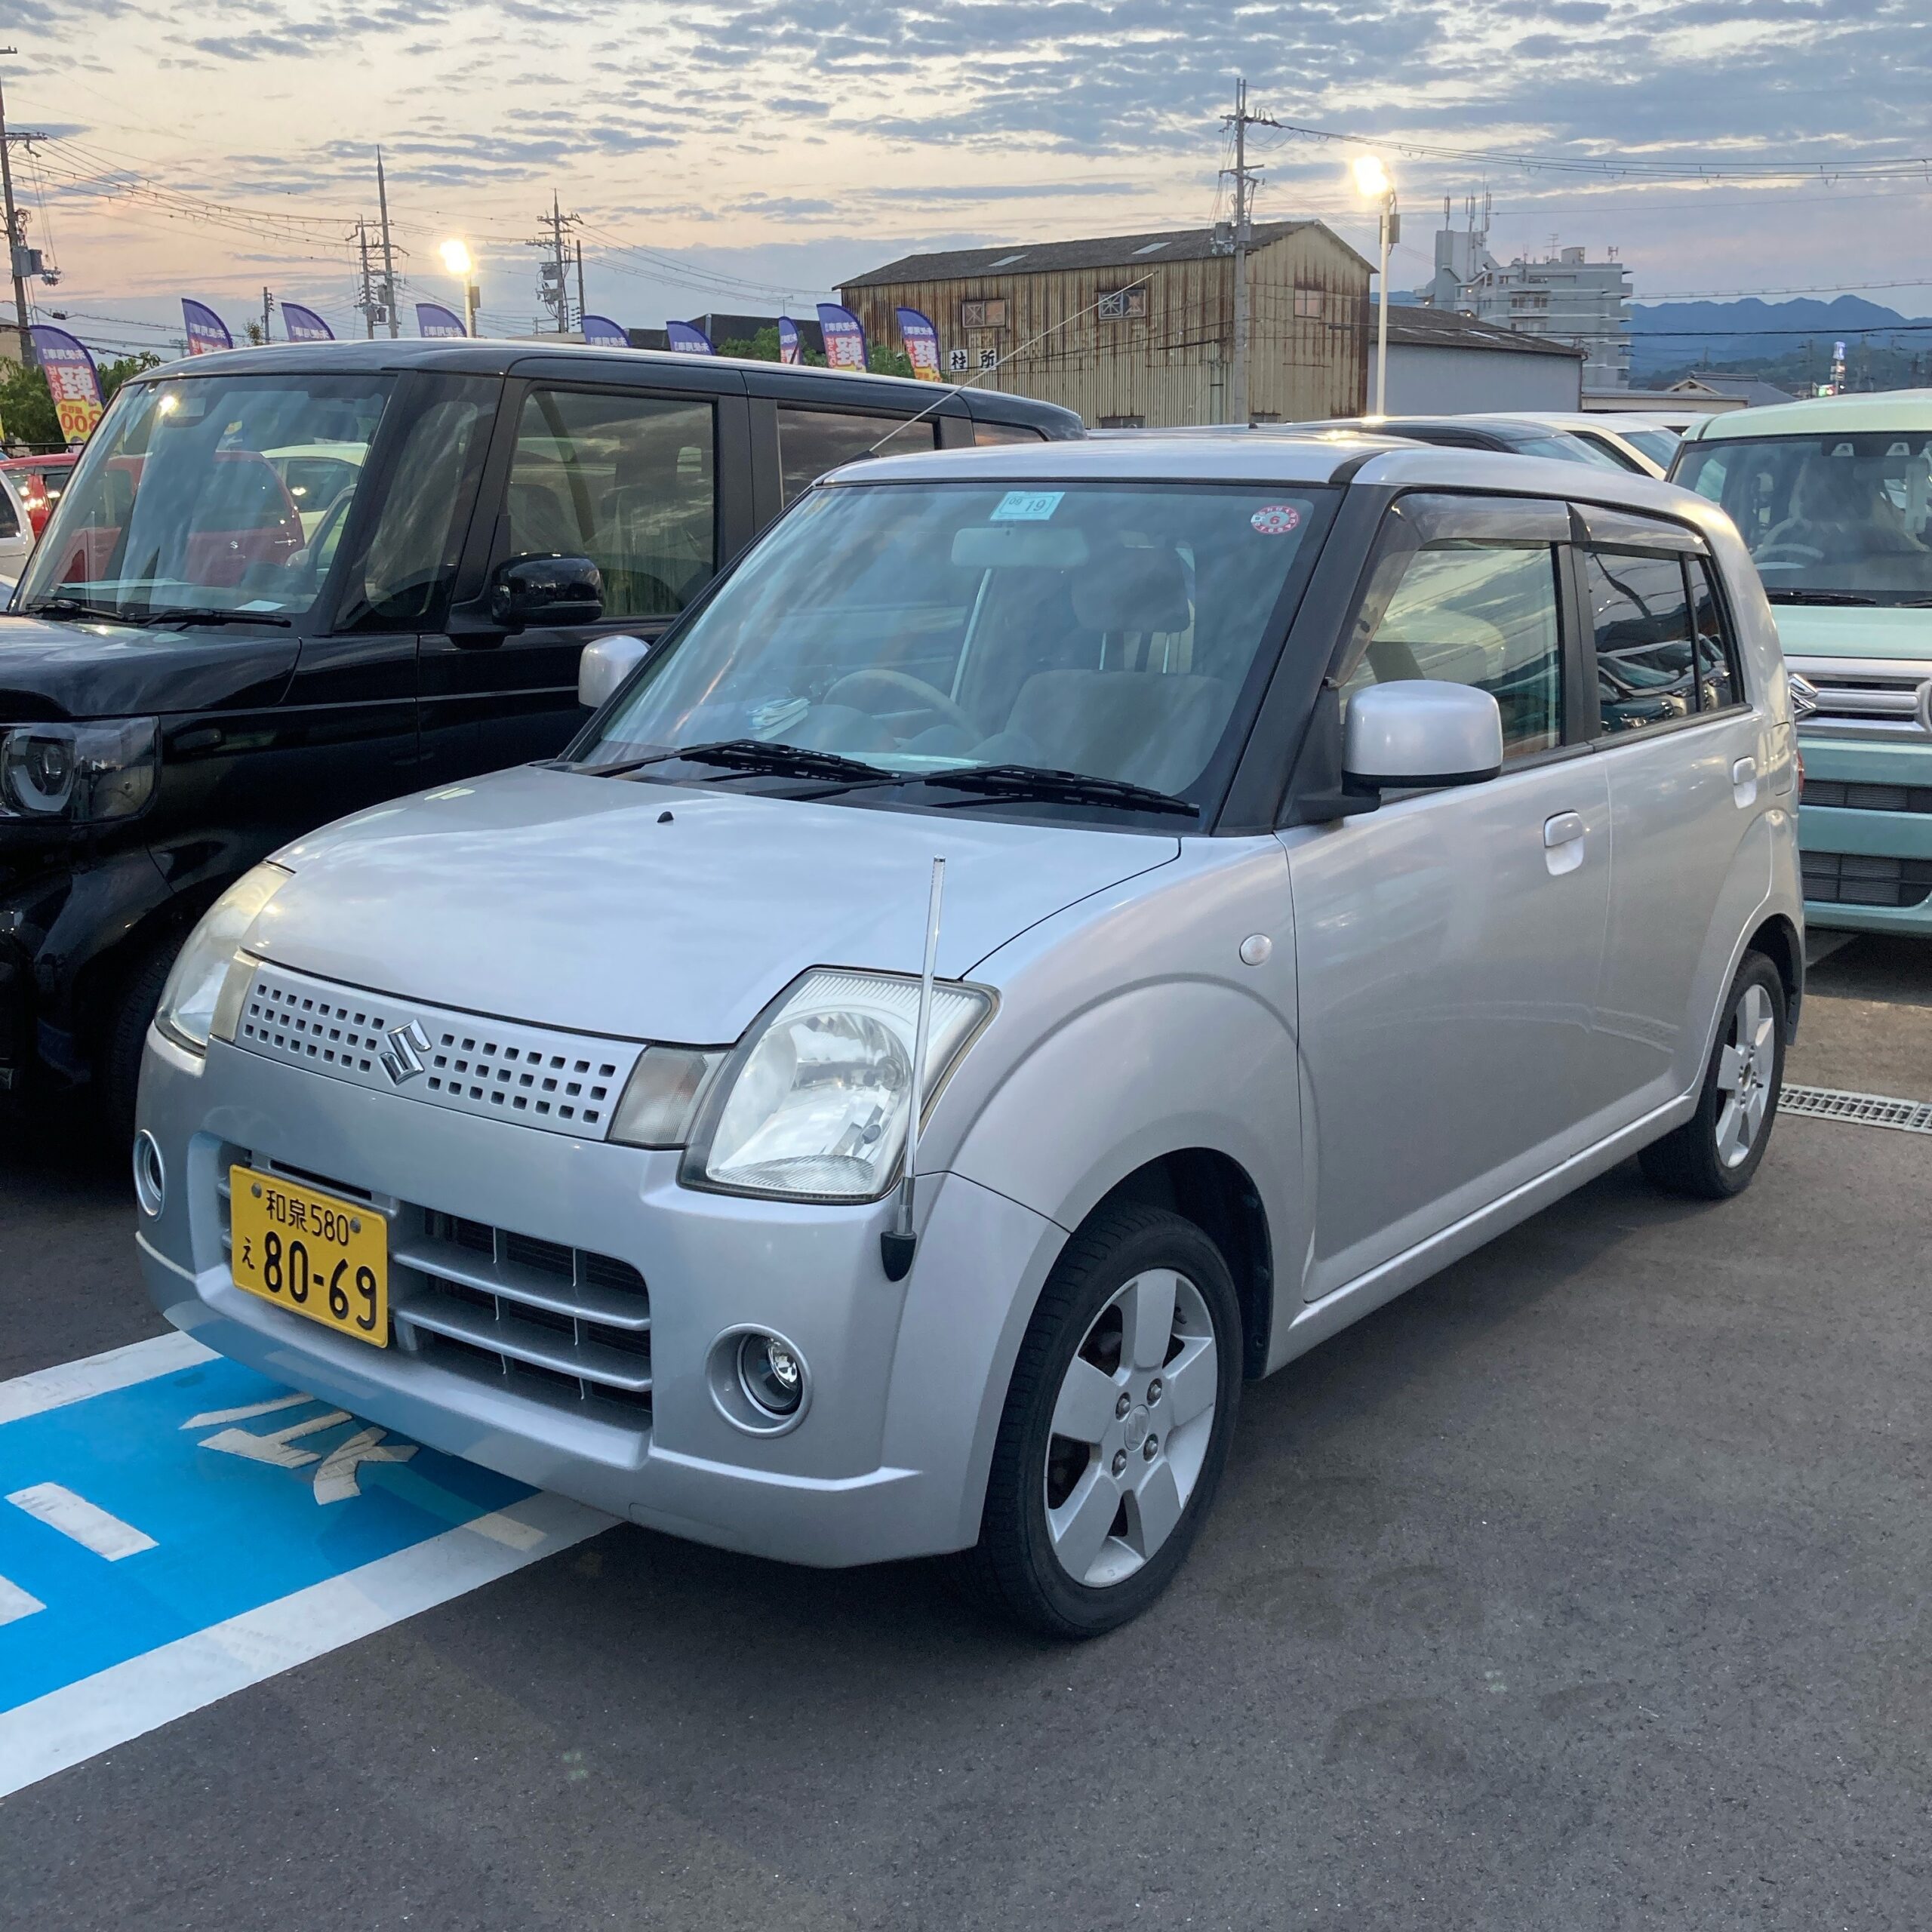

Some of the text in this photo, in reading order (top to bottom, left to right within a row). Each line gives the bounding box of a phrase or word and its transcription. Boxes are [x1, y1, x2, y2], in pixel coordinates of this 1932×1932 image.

[1026, 500, 1046, 512] 19
[1269, 515, 1281, 525] 6
[242, 1230, 377, 1331] え 80-69
